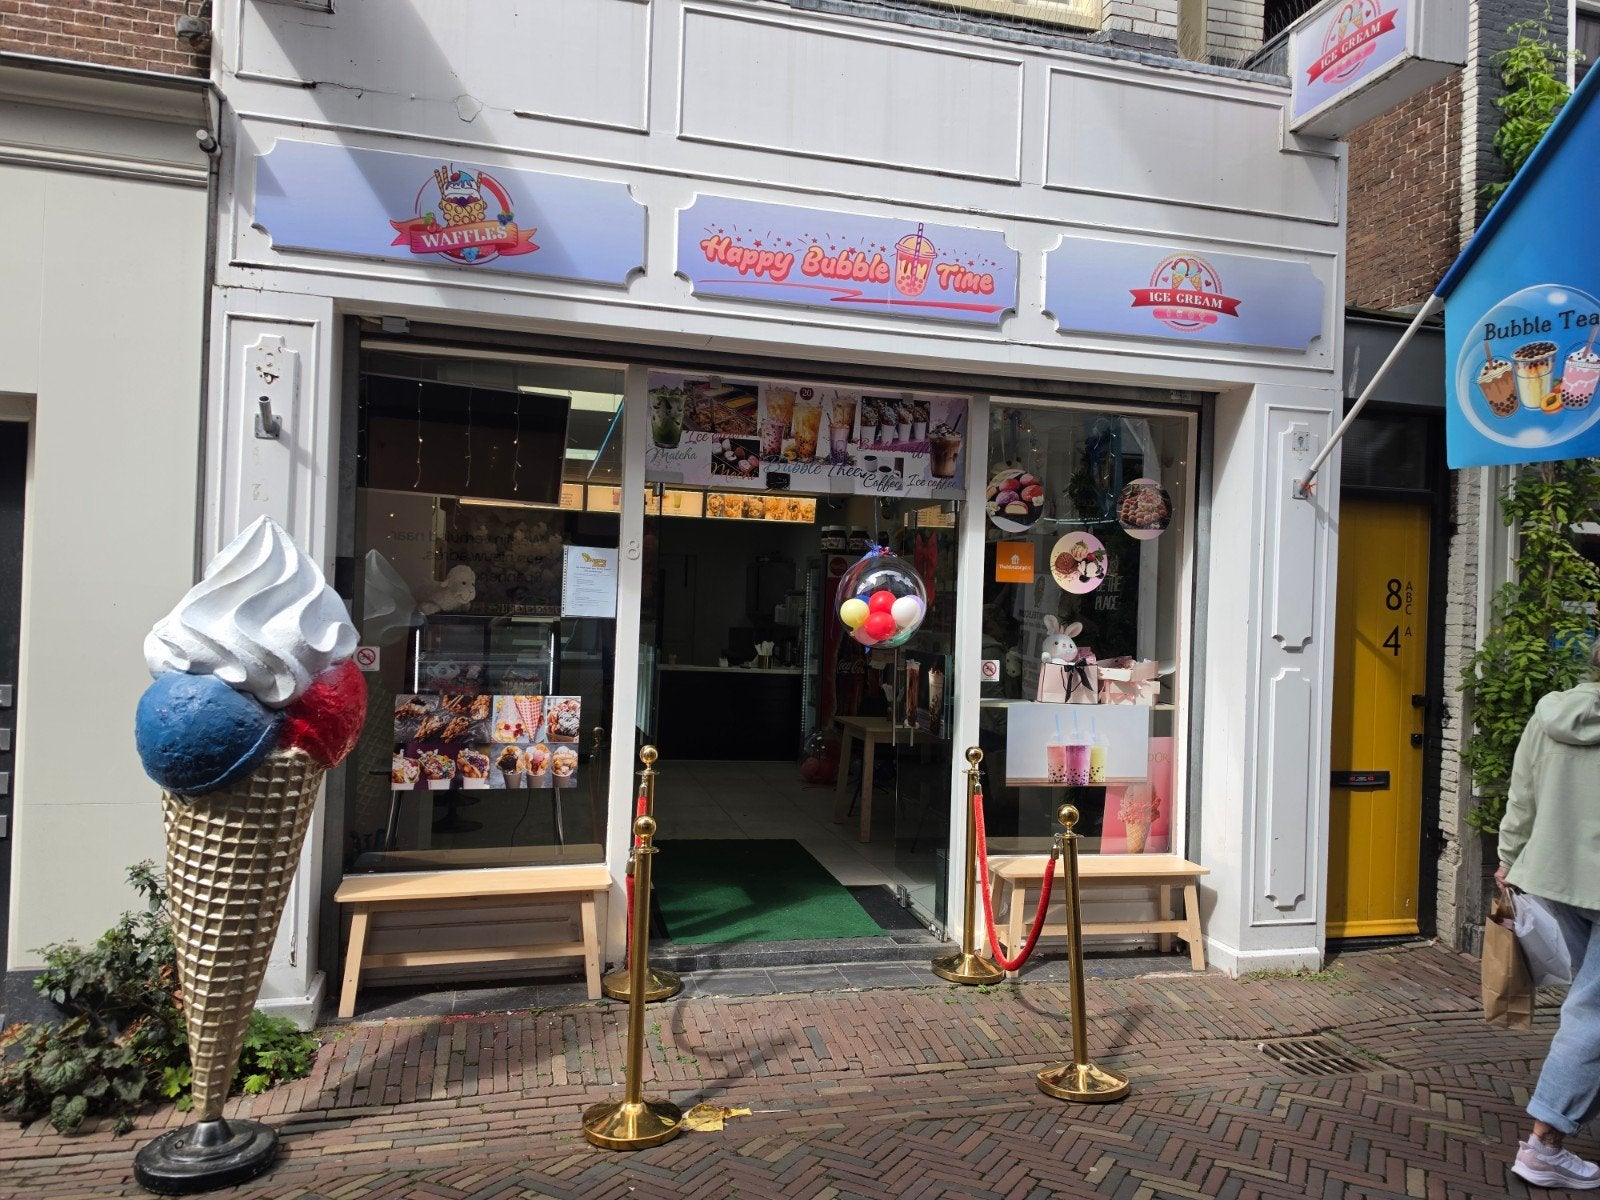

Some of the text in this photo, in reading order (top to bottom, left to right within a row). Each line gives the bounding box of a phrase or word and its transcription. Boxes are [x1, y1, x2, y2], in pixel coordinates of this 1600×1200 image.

[1320, 21, 1382, 70] ICE CREAM
[421, 225, 508, 249] WAFFLES
[700, 235, 995, 296] Happy Bubble Time
[1150, 291, 1223, 309] ICE CREAM
[1484, 310, 1600, 341] Bubble Tea
[685, 430, 709, 444] Ice
[646, 447, 697, 464] Matcha
[763, 457, 822, 474] Bubble
[906, 474, 925, 487] Ice
[627, 540, 640, 560] 8
[1386, 578, 1402, 611] 8
[1405, 581, 1413, 592] A
[1095, 595, 1120, 611] PLACE
[1405, 592, 1413, 603] B
[1405, 604, 1412, 615] C
[1404, 626, 1412, 637] A
[1383, 625, 1401, 656] 4
